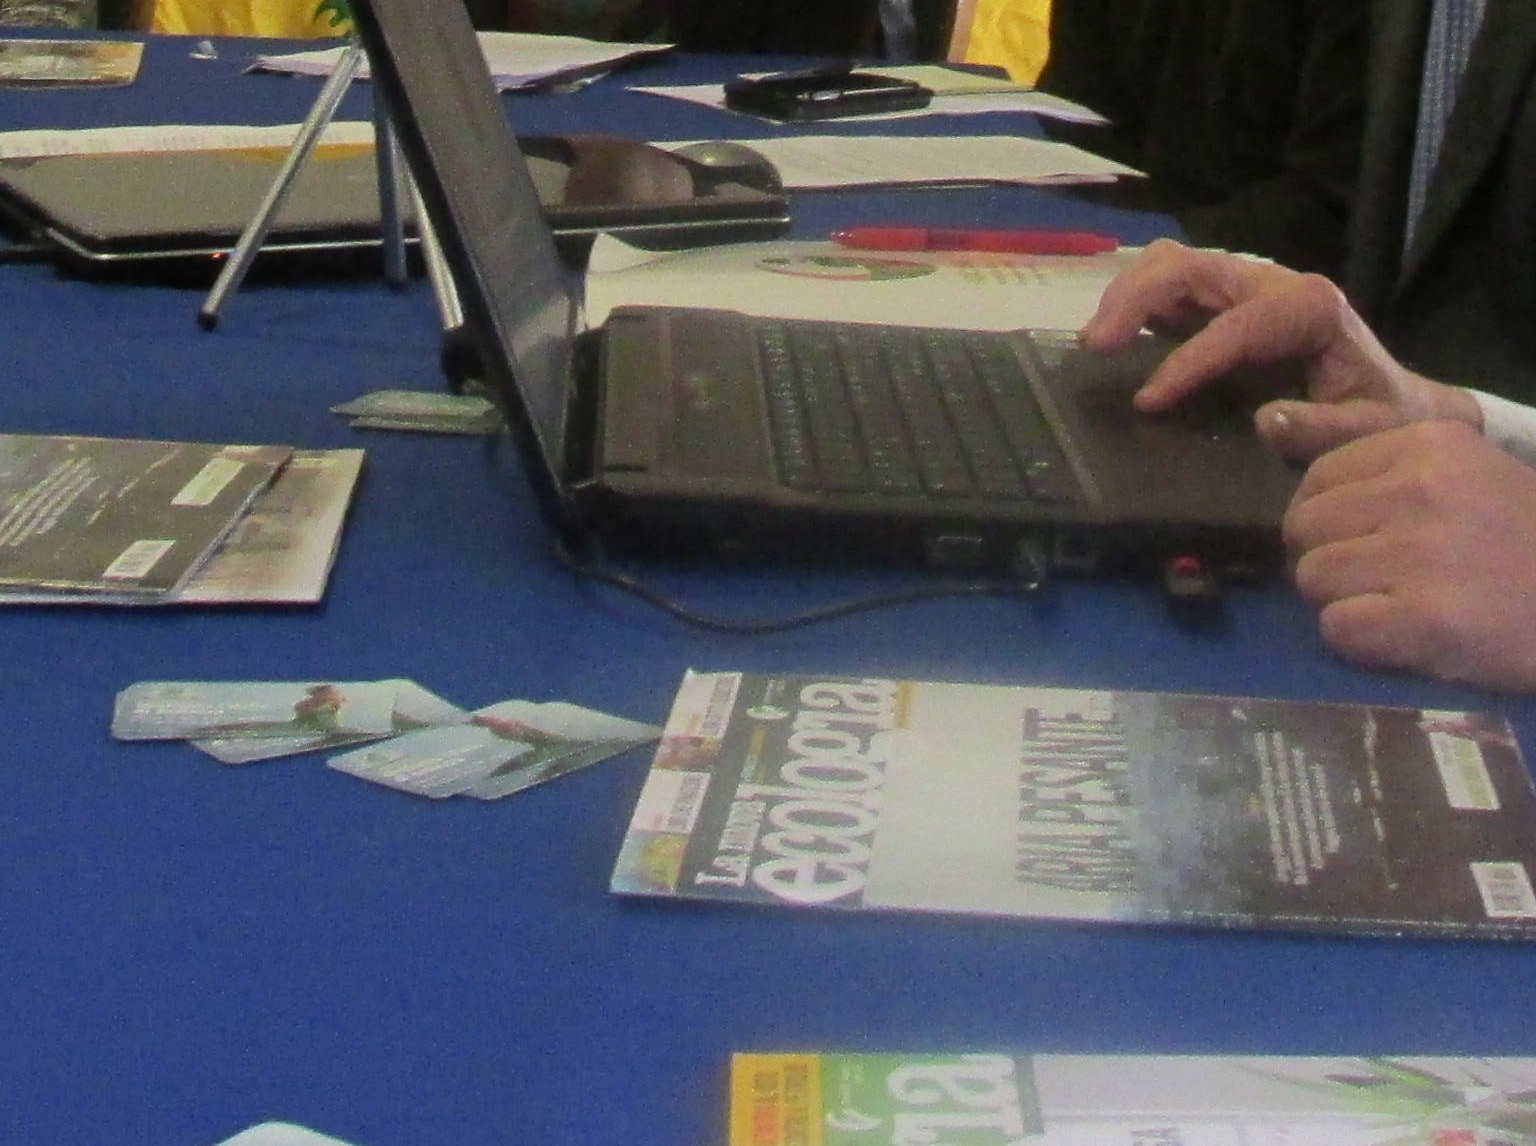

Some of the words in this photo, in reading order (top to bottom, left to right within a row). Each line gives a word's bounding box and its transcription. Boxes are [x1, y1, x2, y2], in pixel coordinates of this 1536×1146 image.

[733, 679, 896, 904] ecologia
[1019, 707, 1132, 828] PESANTE
[1015, 832, 1136, 893] ARIA
